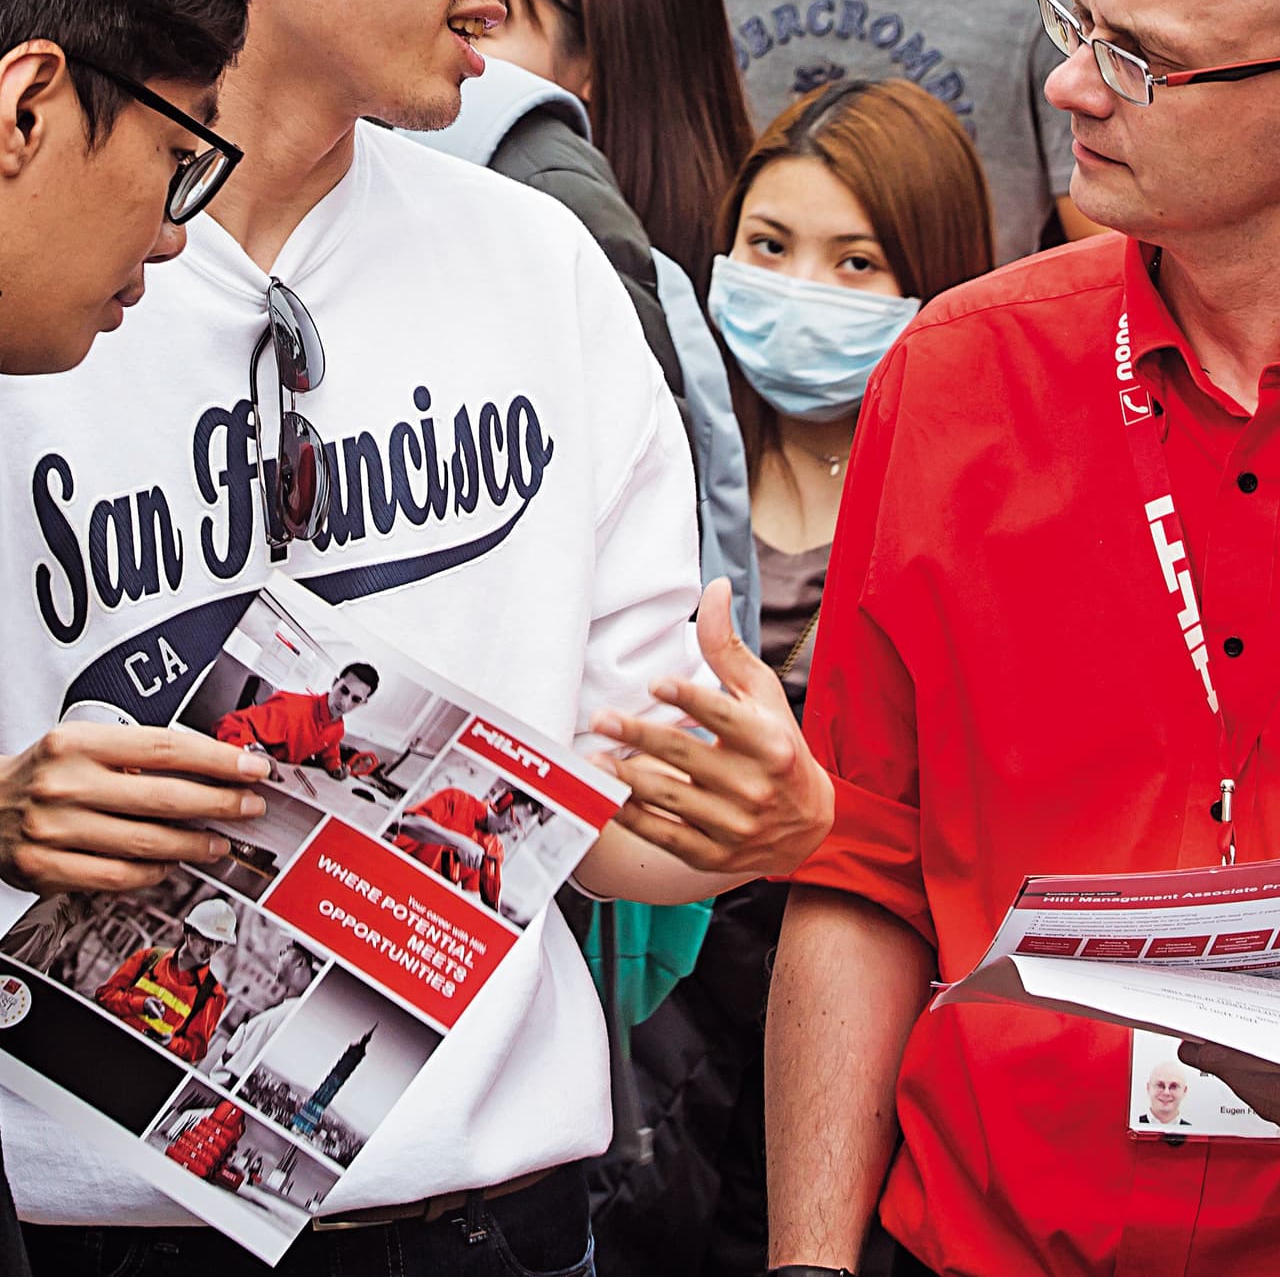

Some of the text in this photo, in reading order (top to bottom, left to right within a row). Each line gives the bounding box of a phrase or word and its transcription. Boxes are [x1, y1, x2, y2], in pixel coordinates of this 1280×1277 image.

[33, 453, 183, 645] San
[123, 635, 190, 698] CA
[471, 722, 551, 779] HILTI
[317, 853, 475, 971] WHERE POTENTIAL
[1042, 896, 1075, 904] Hilti
[1078, 892, 1179, 904] Management
[1182, 886, 1258, 899] Associate
[317, 898, 457, 1000] OPPORTUNITIES
[406, 933, 468, 985] MEETS
[1220, 1106, 1246, 1116] Eugen
